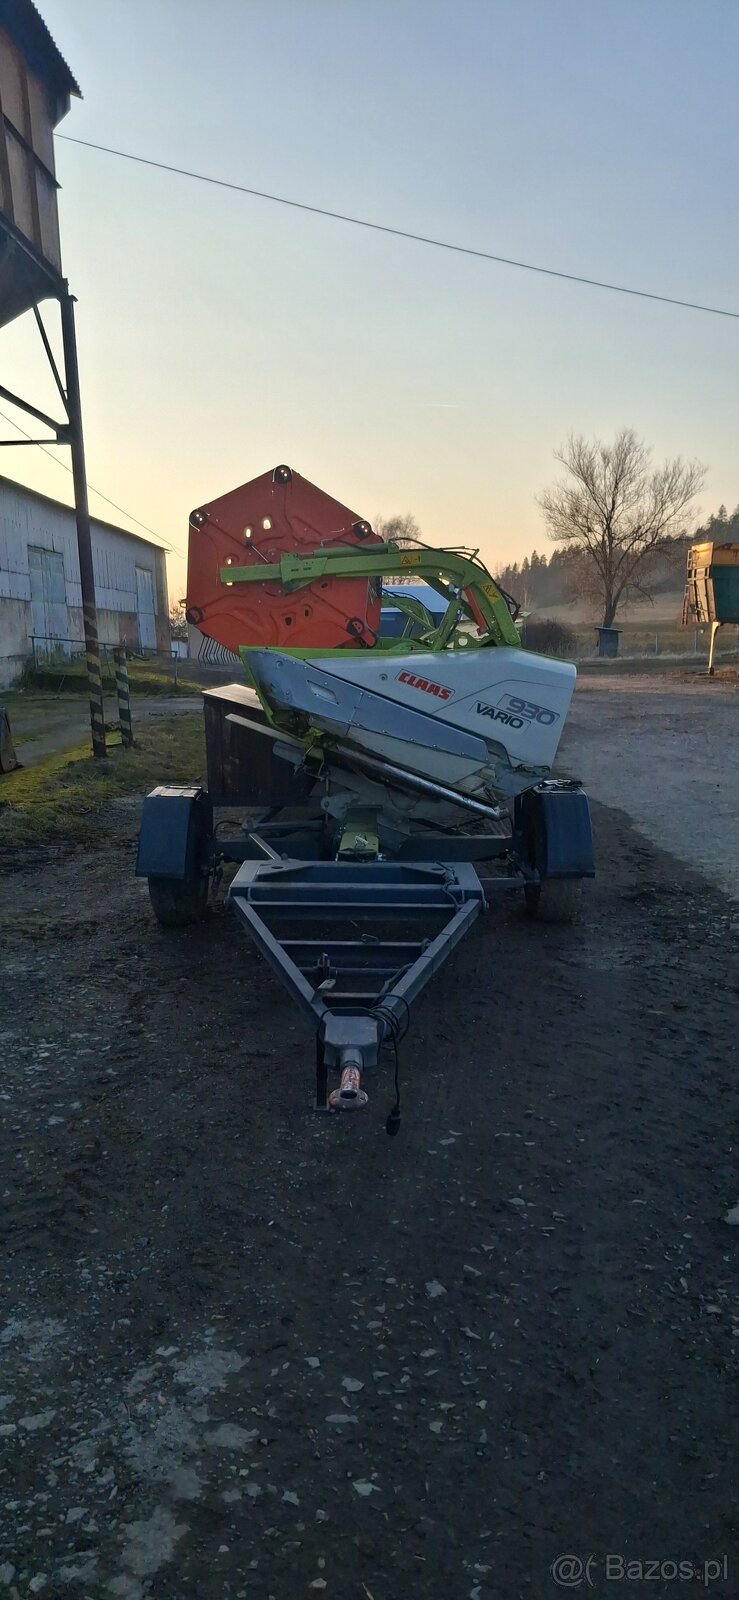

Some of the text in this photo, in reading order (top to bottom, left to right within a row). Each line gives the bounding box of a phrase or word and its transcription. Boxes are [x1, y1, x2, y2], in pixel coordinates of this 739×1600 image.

[398, 672, 451, 701] CLAAS
[475, 702, 524, 729] VARIO
[505, 699, 556, 725] 930
